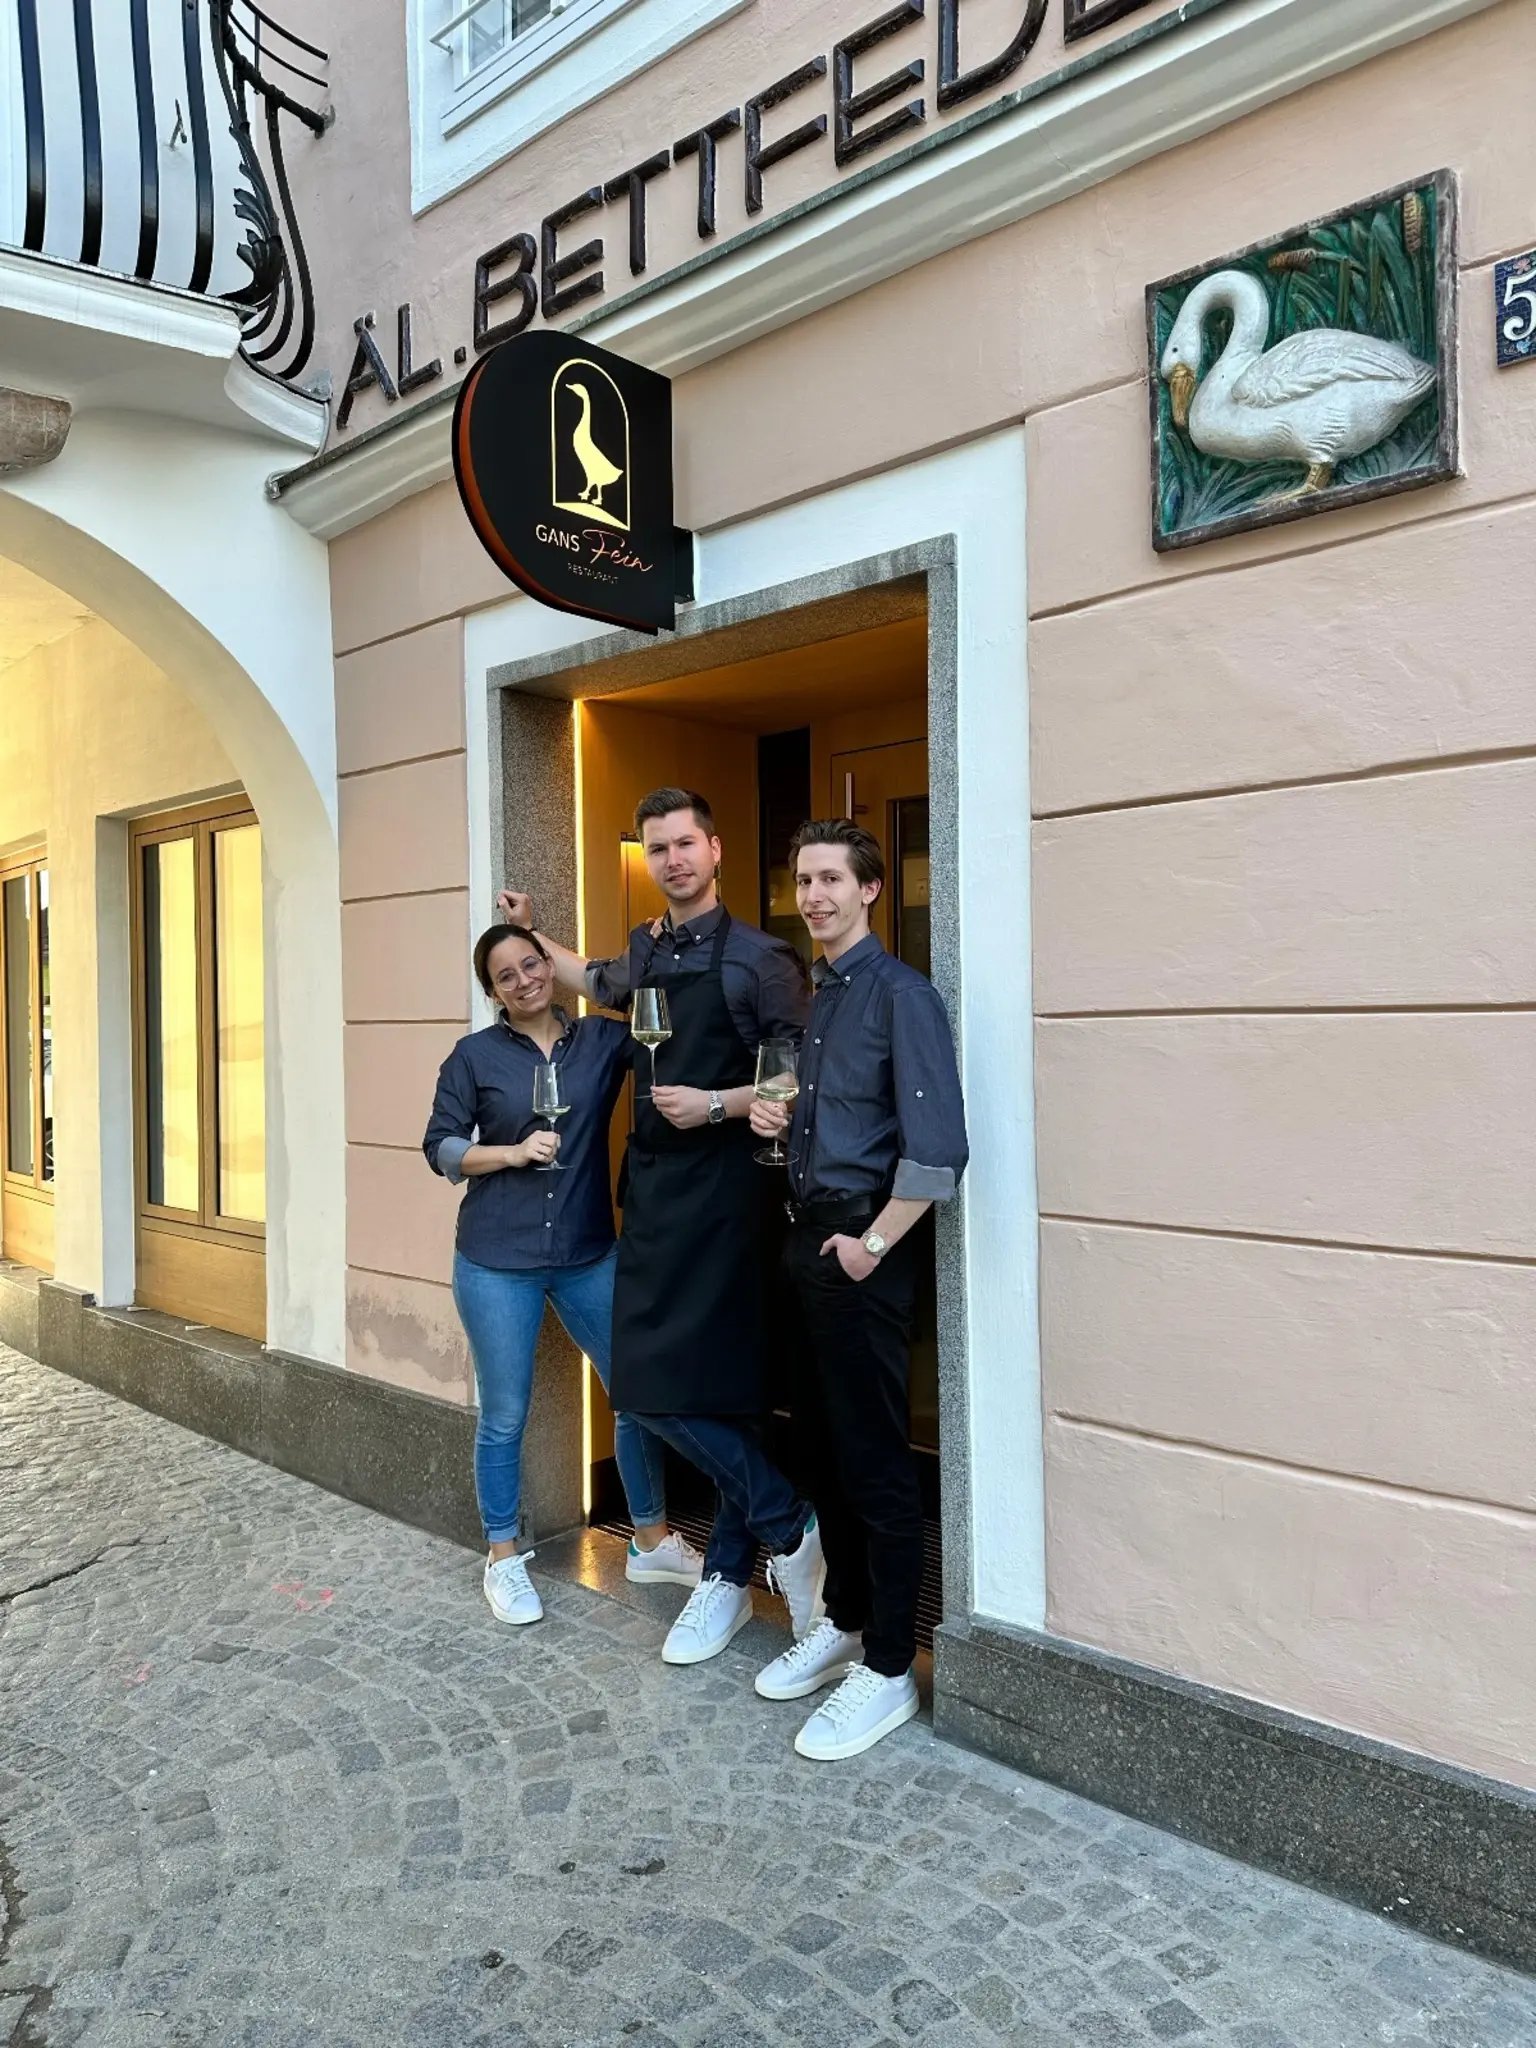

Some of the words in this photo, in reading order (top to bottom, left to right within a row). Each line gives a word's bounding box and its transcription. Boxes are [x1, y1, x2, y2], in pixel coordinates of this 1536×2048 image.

[1503, 269, 1536, 341] 5
[535, 524, 580, 552] GANS
[582, 529, 653, 572] Fein
